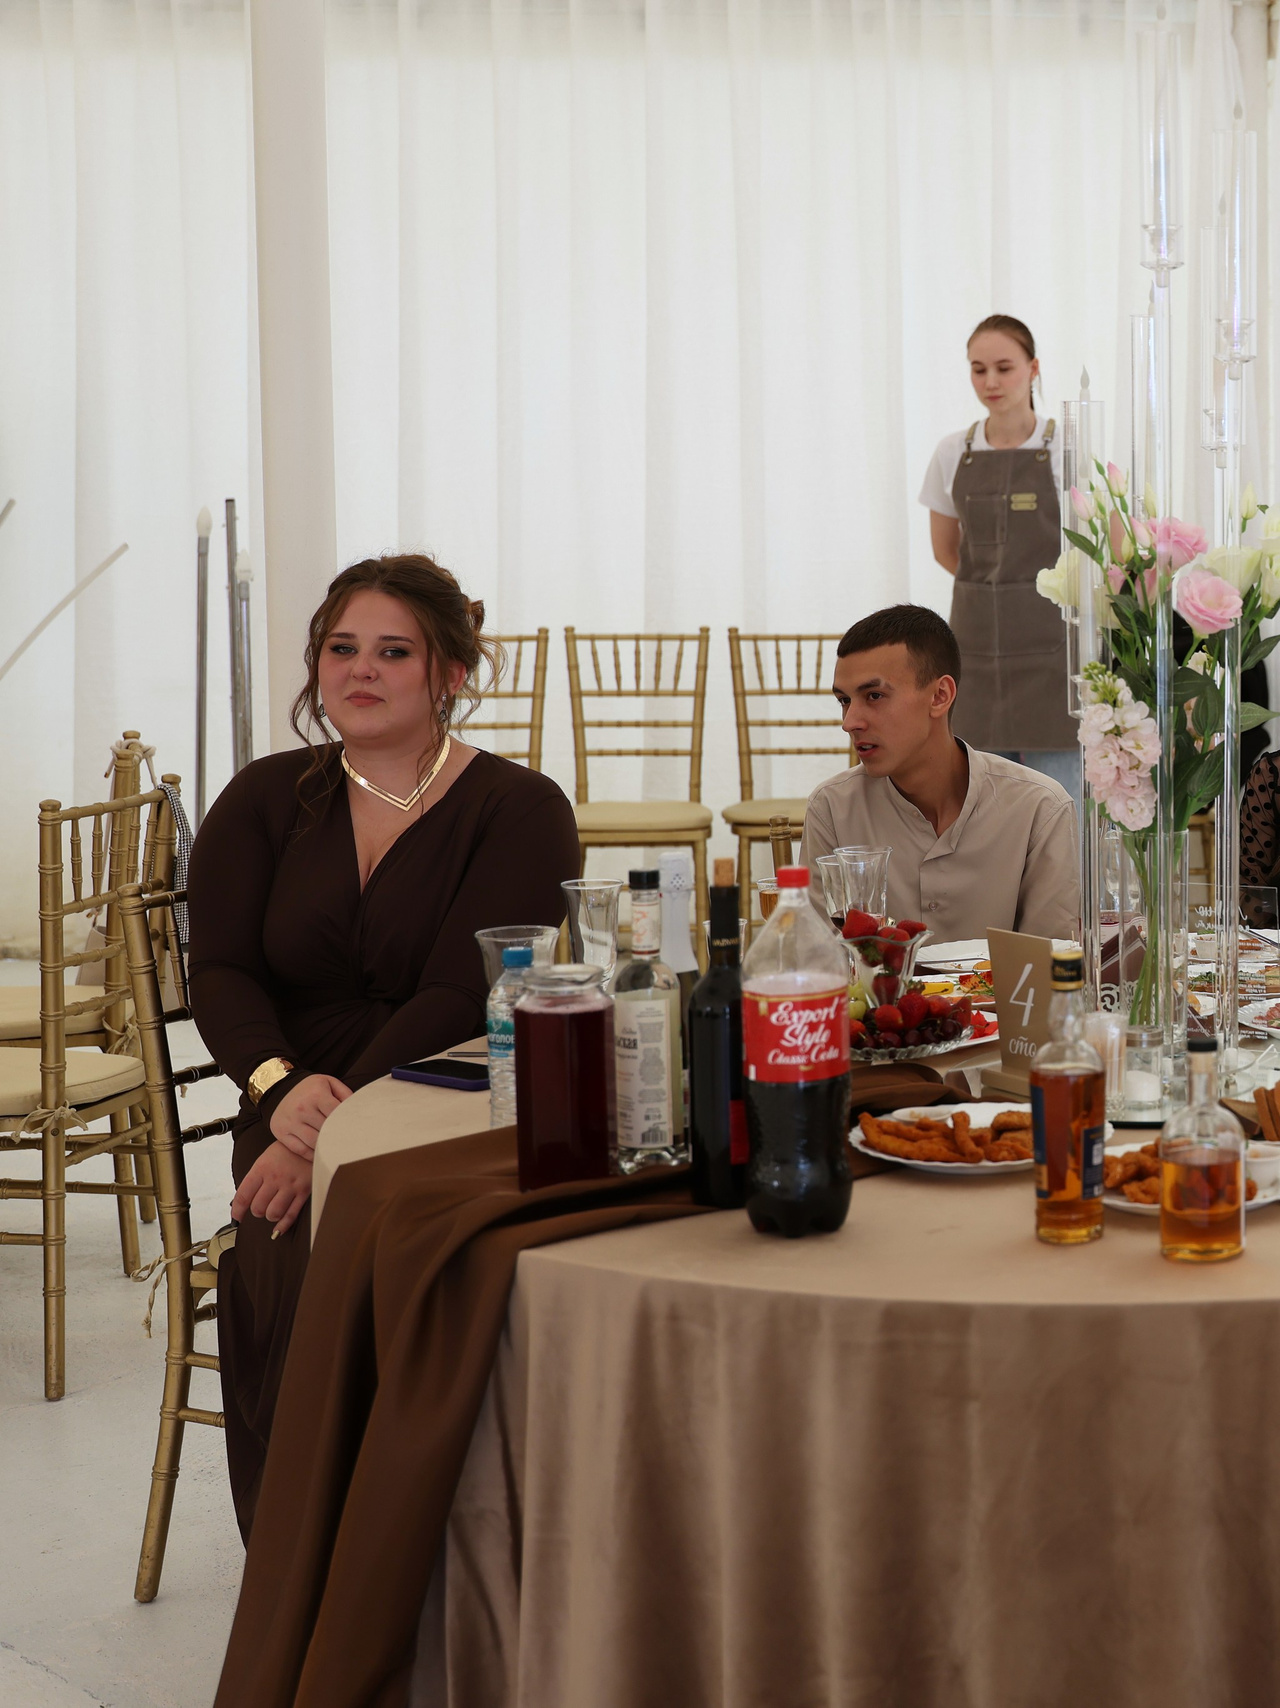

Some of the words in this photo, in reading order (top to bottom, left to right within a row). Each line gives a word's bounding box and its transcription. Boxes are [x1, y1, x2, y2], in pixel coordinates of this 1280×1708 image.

[1009, 963, 1034, 1027] 4
[770, 996, 840, 1030] Export
[779, 1022, 832, 1053] Style
[1009, 1036, 1037, 1058] сто
[767, 1048, 810, 1065] Classic
[810, 1043, 840, 1063] Cola
